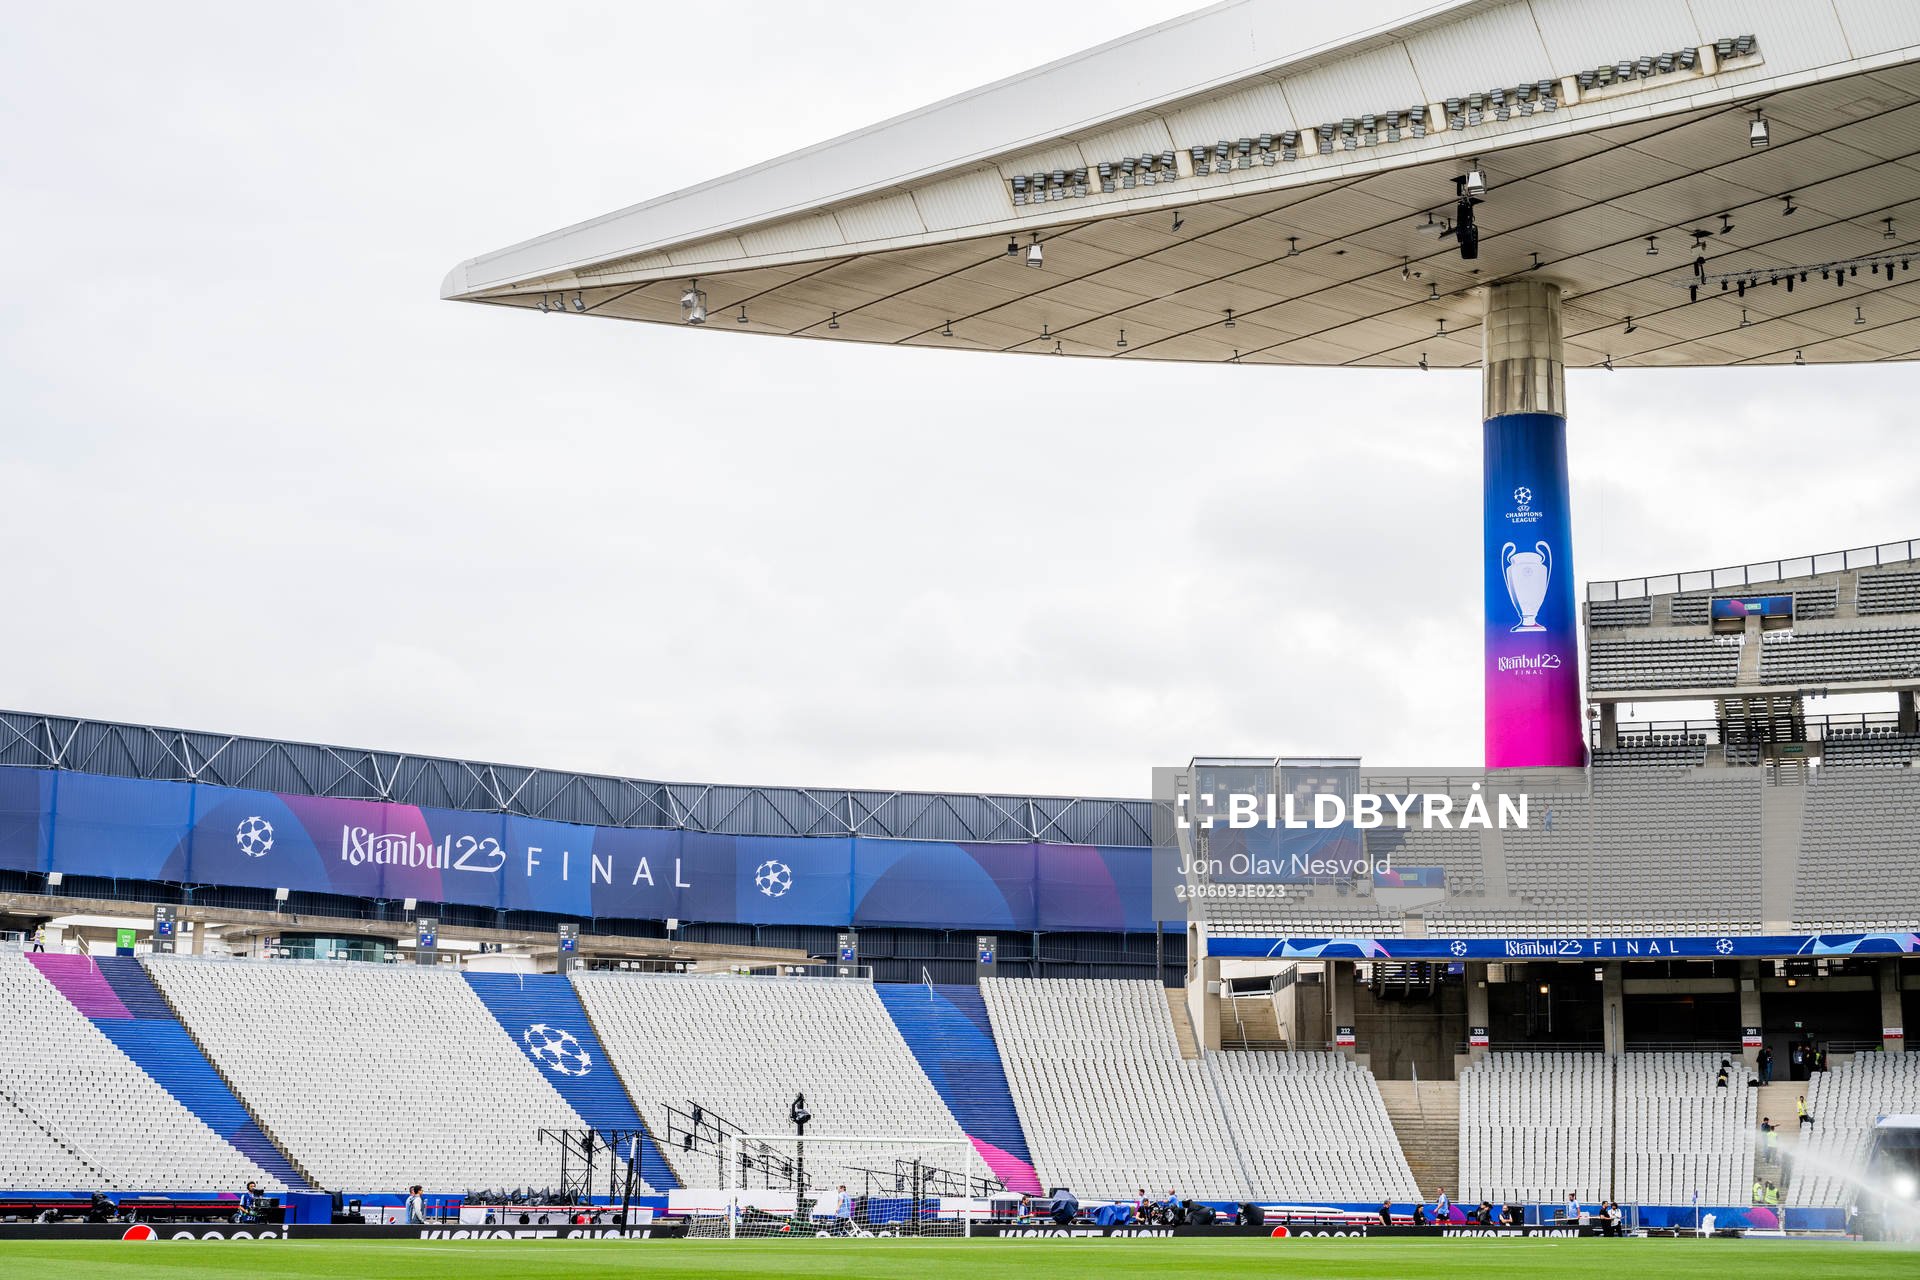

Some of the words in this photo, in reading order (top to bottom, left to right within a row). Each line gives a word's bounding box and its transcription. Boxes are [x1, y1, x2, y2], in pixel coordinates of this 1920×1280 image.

[1505, 511, 1543, 519] CHAMPIONS
[527, 847, 691, 888] FINAL
[1594, 940, 1679, 955] FINAL
